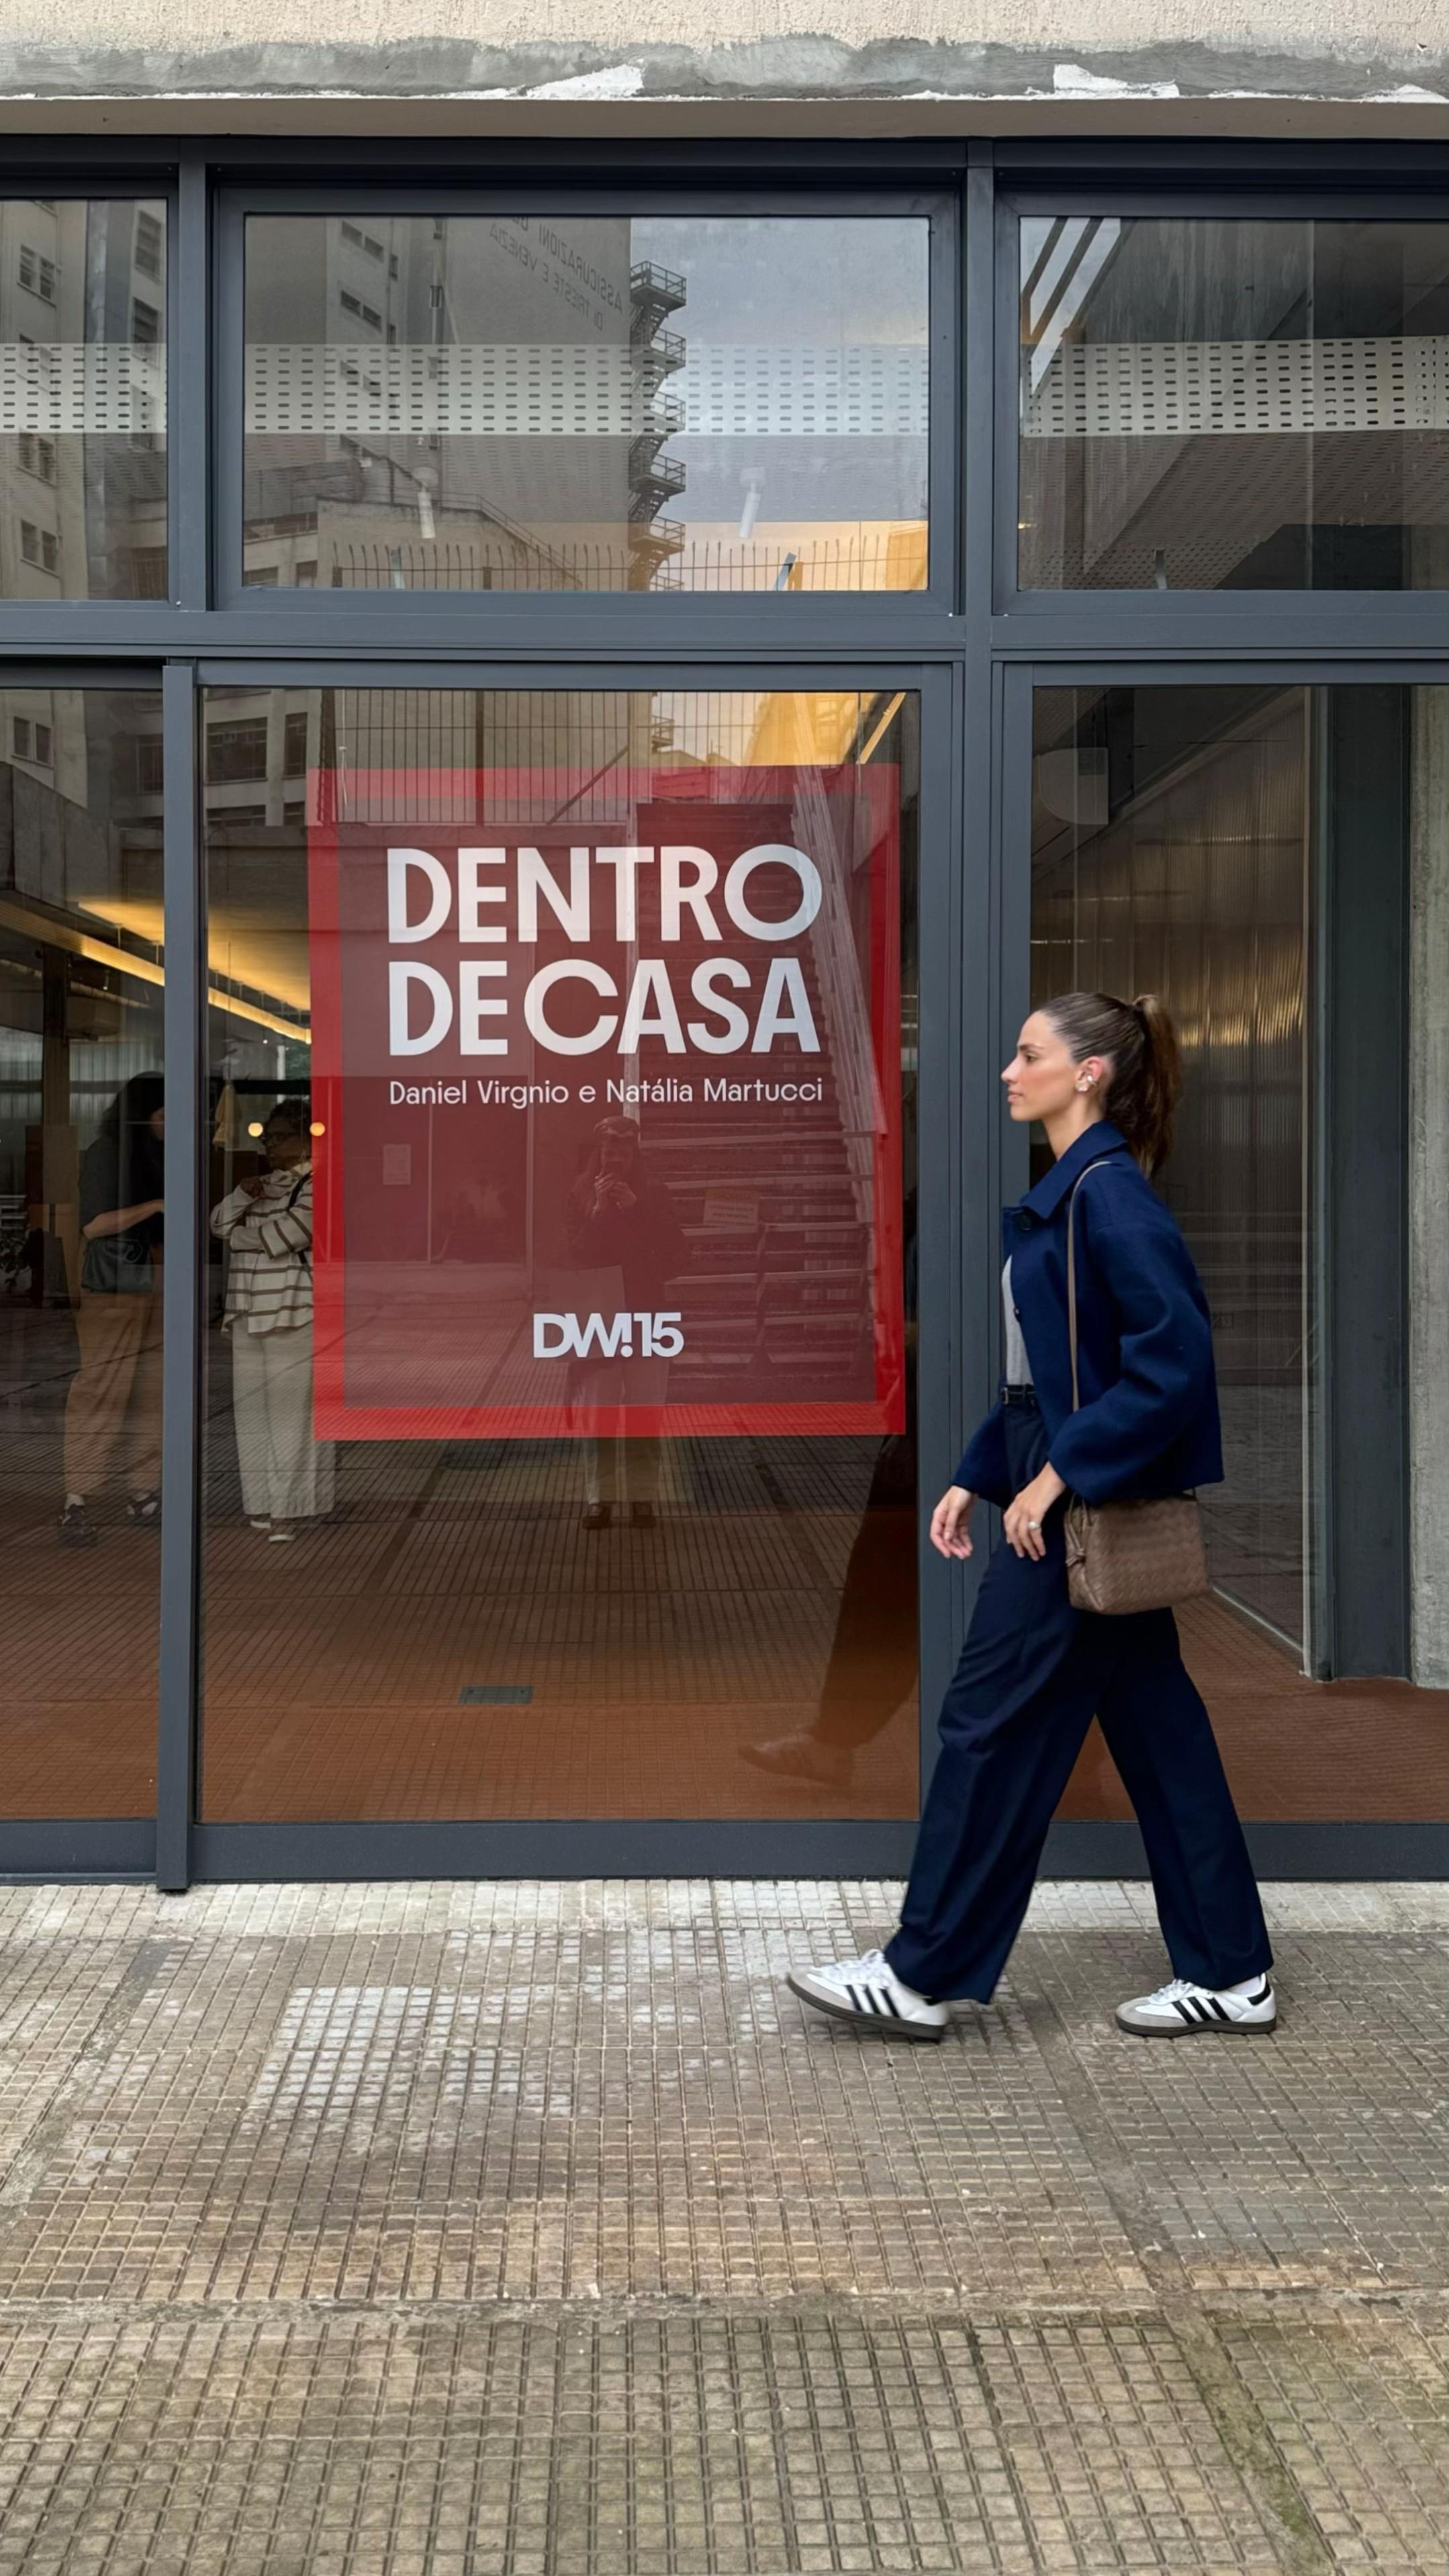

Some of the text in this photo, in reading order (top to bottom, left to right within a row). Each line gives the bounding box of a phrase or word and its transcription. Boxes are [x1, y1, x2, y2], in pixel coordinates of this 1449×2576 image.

[387, 843, 822, 943] DENTRO
[389, 1077, 823, 1109] Daniel Virgnio e Natália Martucci
